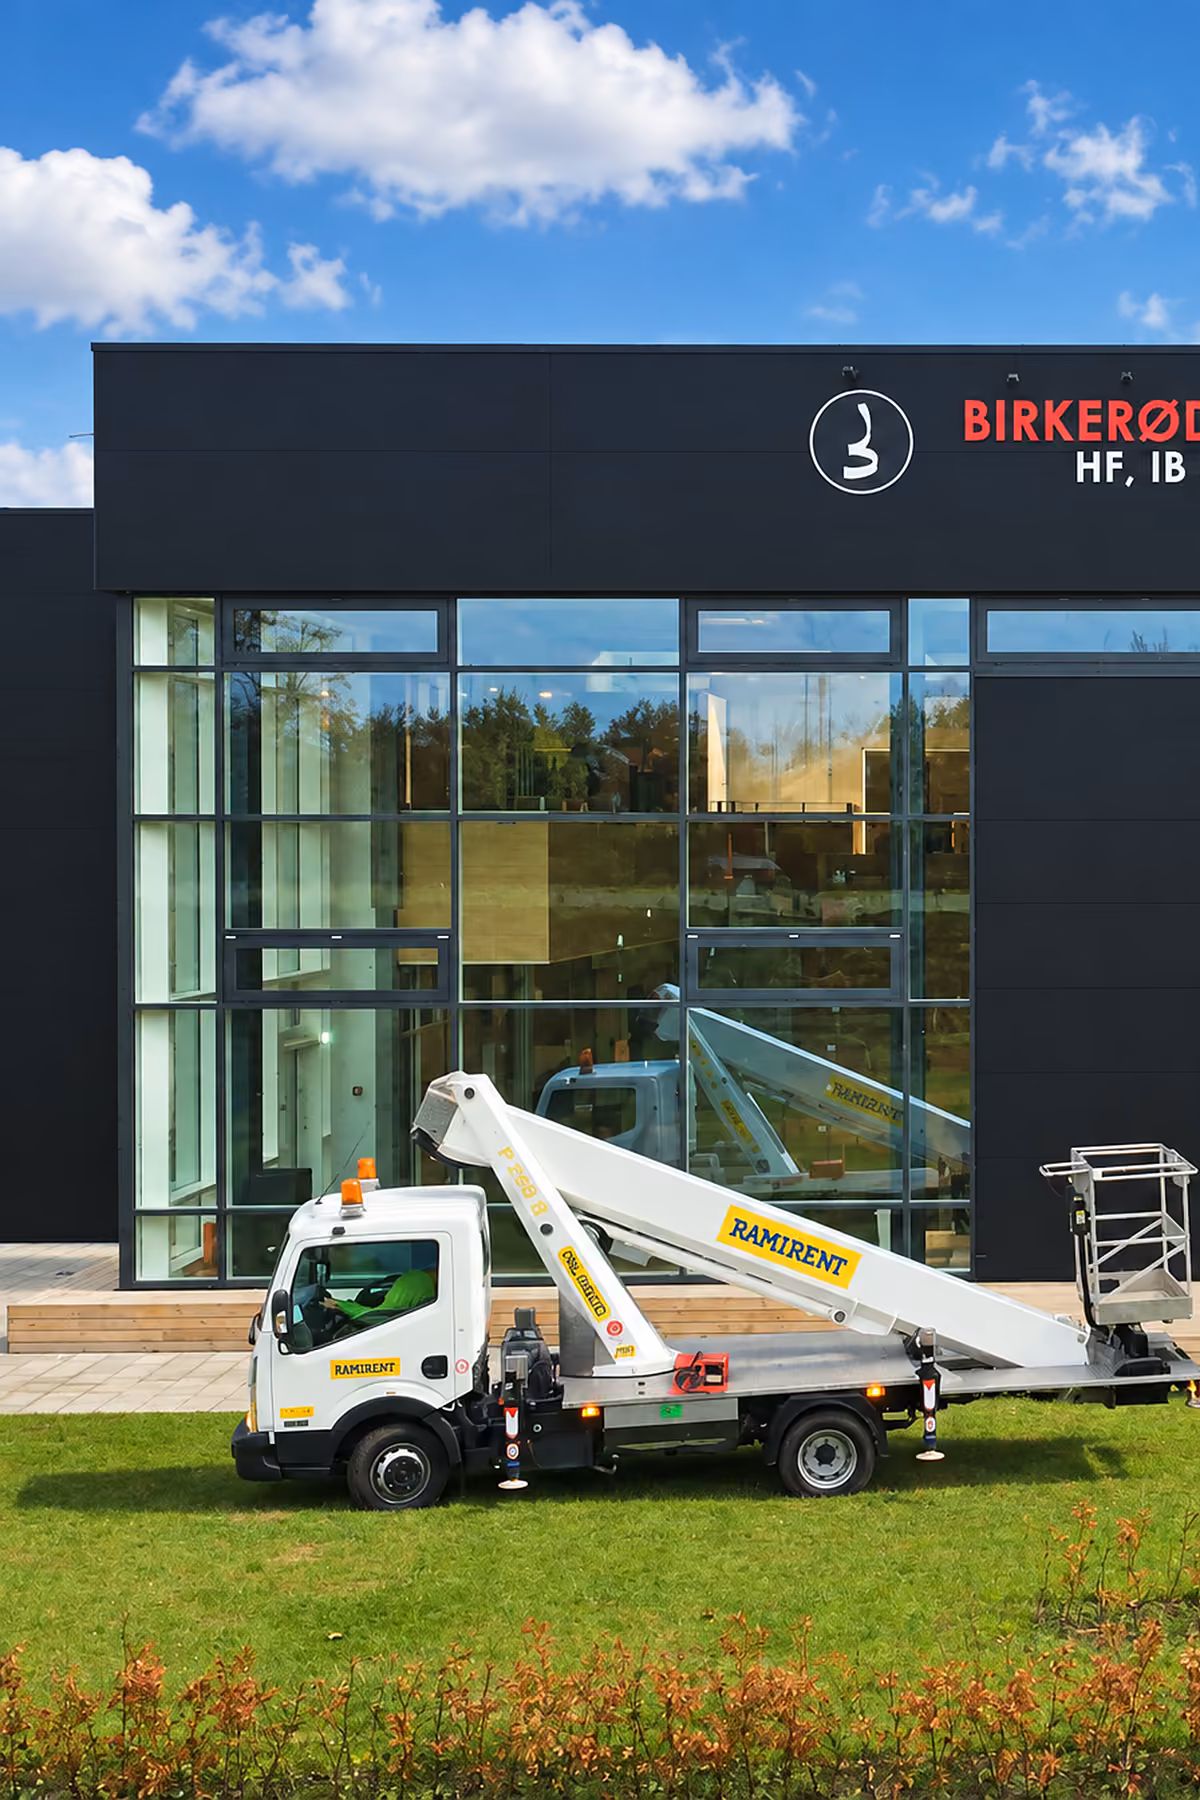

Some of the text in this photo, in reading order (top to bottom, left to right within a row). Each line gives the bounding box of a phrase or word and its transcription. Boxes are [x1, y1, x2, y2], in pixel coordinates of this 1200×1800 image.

[1076, 451, 1135, 488] HF,
[1151, 451, 1187, 483] IB
[729, 1217, 848, 1276] RAMIRENT
[335, 1362, 395, 1375] RAMIRENT
